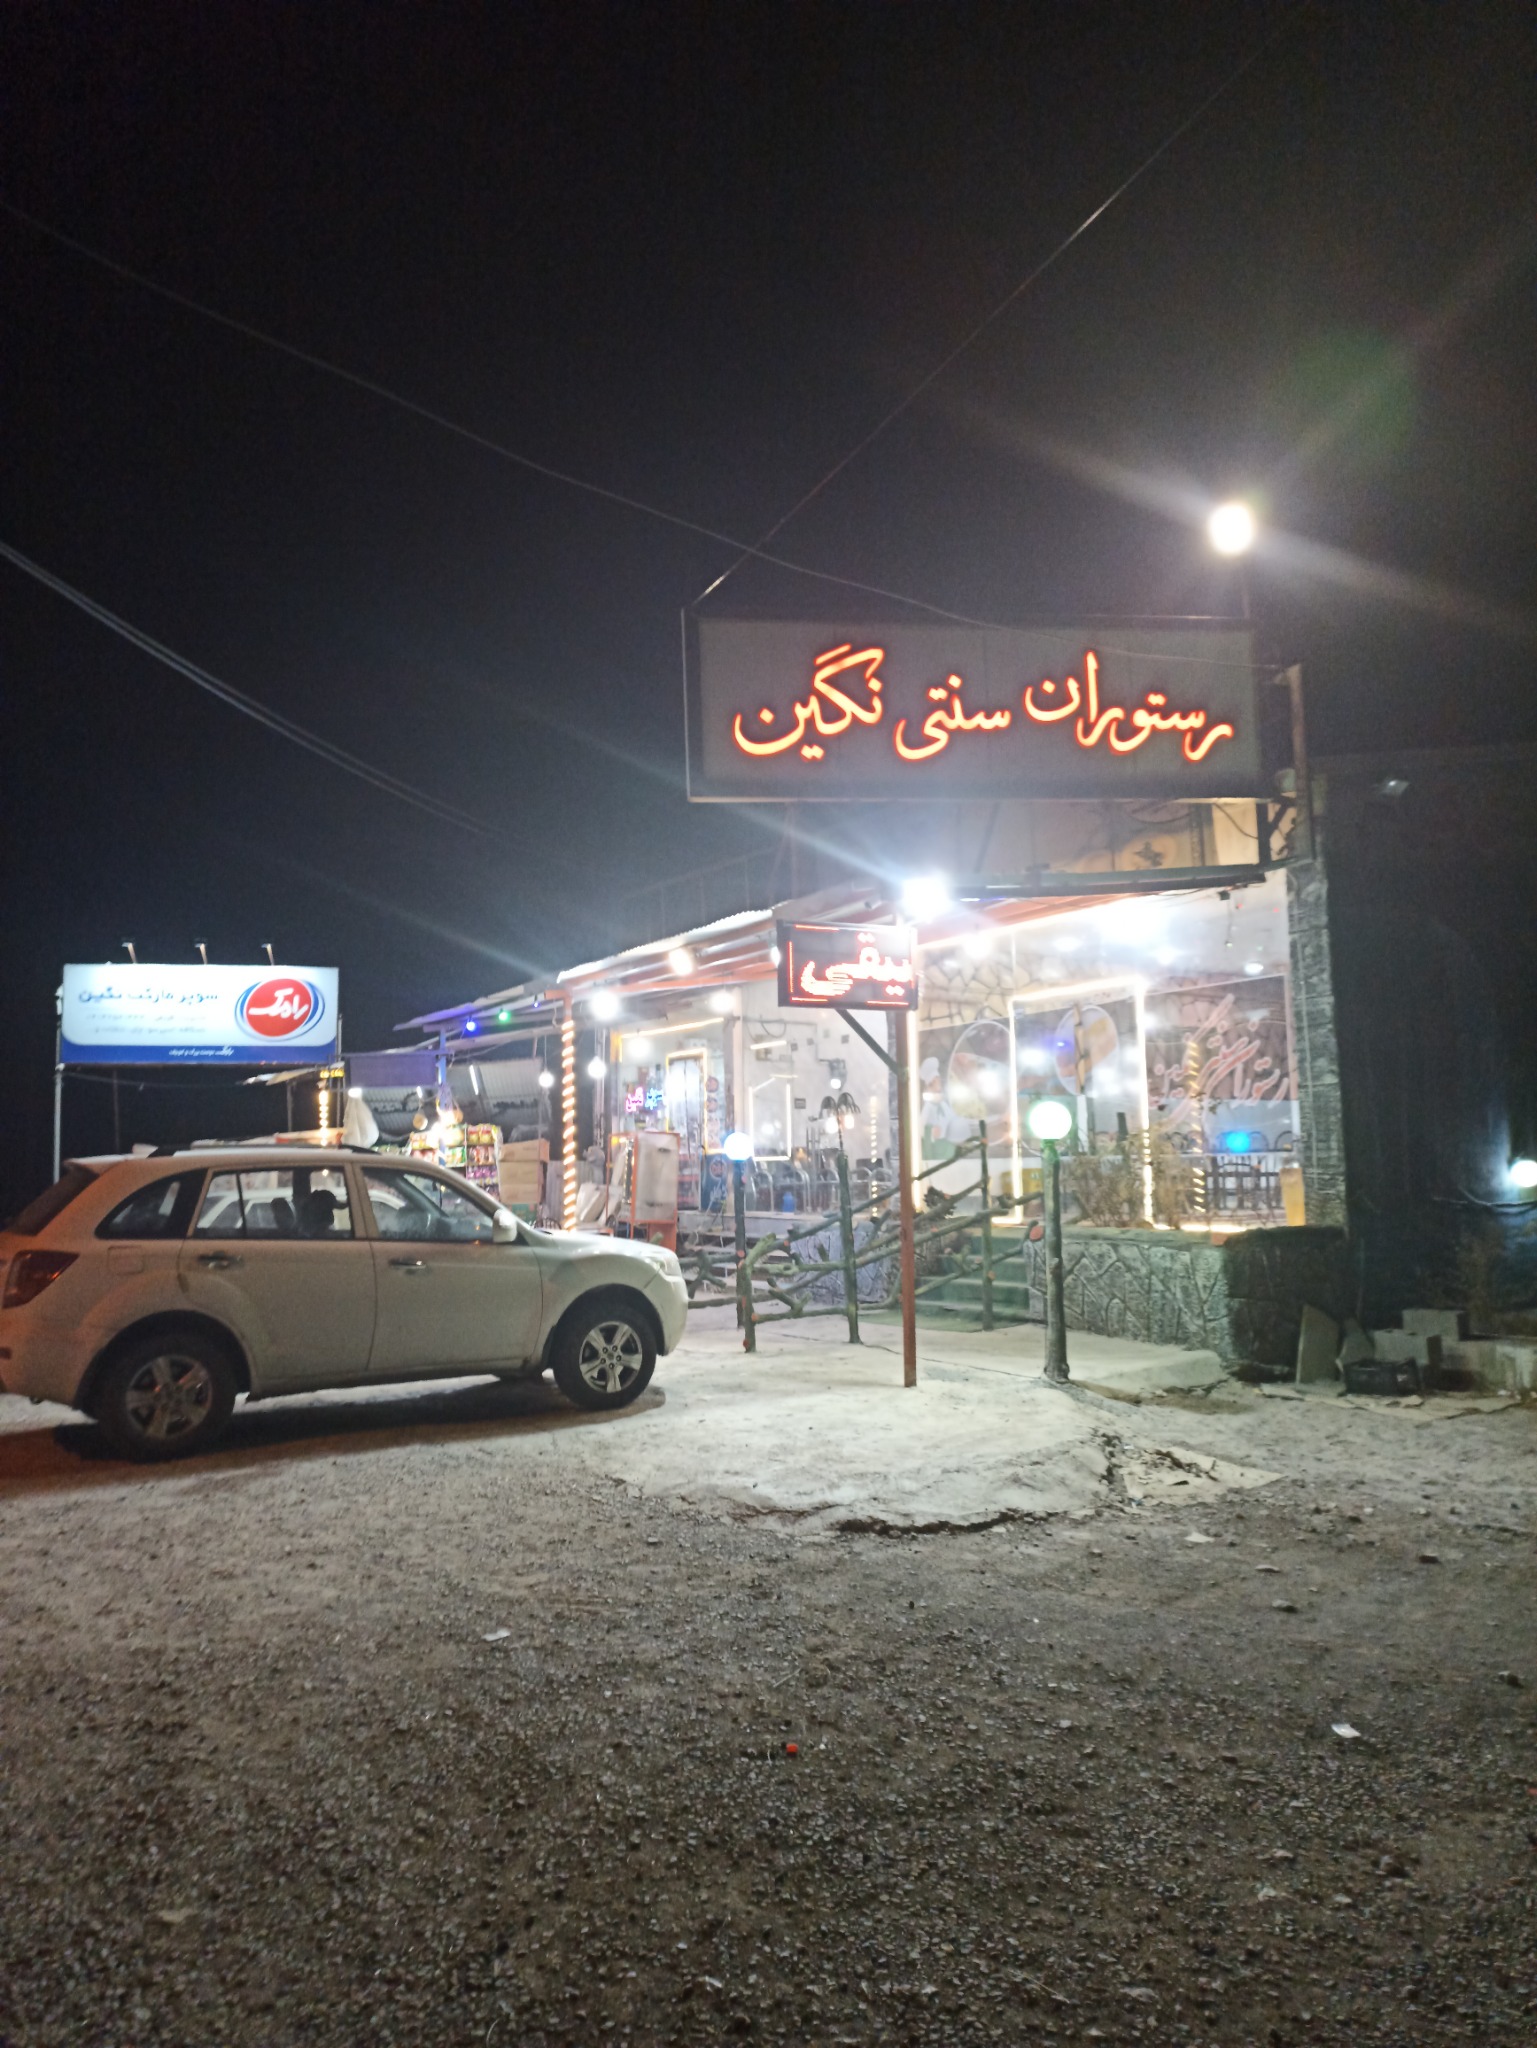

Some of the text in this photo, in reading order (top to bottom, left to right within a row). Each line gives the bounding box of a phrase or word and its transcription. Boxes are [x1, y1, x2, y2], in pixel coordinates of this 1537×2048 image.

[733, 642, 1233, 762] رستوران سنتی نگین
[78, 986, 122, 1004] نگین
[176, 992, 218, 1006] سوپر
[248, 988, 309, 1020] رامک
